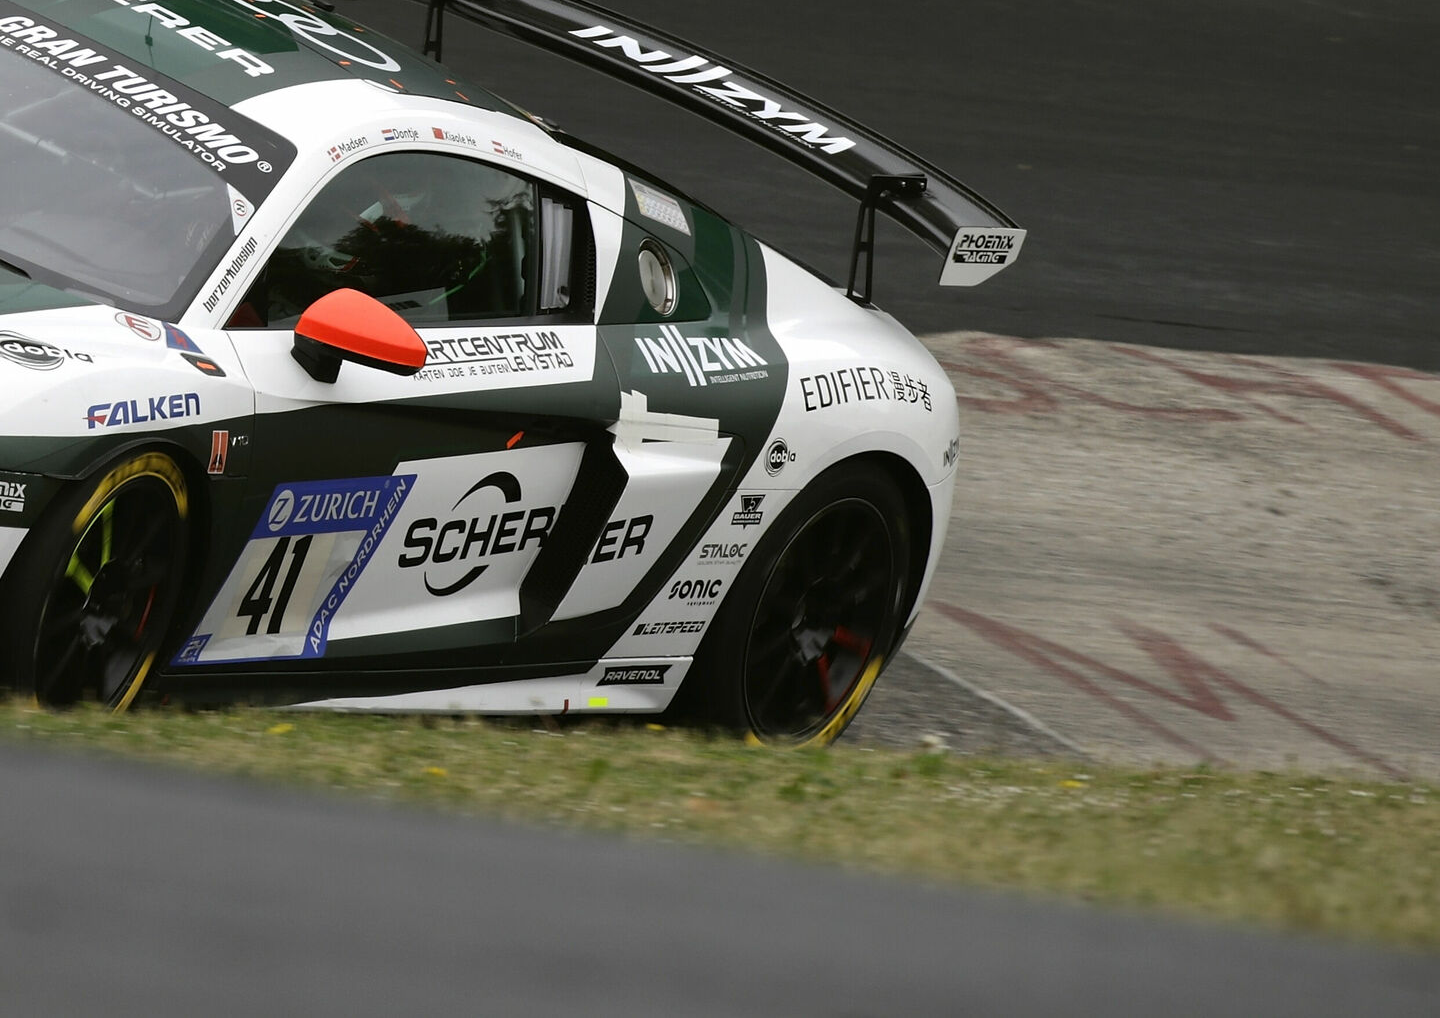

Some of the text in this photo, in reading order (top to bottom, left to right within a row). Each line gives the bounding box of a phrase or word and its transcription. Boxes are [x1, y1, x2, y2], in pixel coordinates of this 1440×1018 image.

[15, 43, 59, 70] REAL
[61, 67, 130, 109] DRIVING
[131, 105, 227, 172] SIMULATOR
[338, 135, 369, 155] Madsen
[392, 128, 420, 142] Dontje
[466, 137, 478, 147] He
[3, 340, 94, 364] dobla
[508, 352, 574, 373] LELYSTAD
[447, 367, 465, 378] DOE
[800, 367, 890, 412] EDIFIER
[86, 392, 201, 430] FALKEN
[769, 450, 796, 463] dobla
[293, 490, 380, 524] ZURICH
[699, 543, 748, 559] STALOC
[310, 478, 407, 654] ADAC NORDRHEIN
[237, 534, 315, 636] 41
[605, 669, 661, 682] RAVENOL
